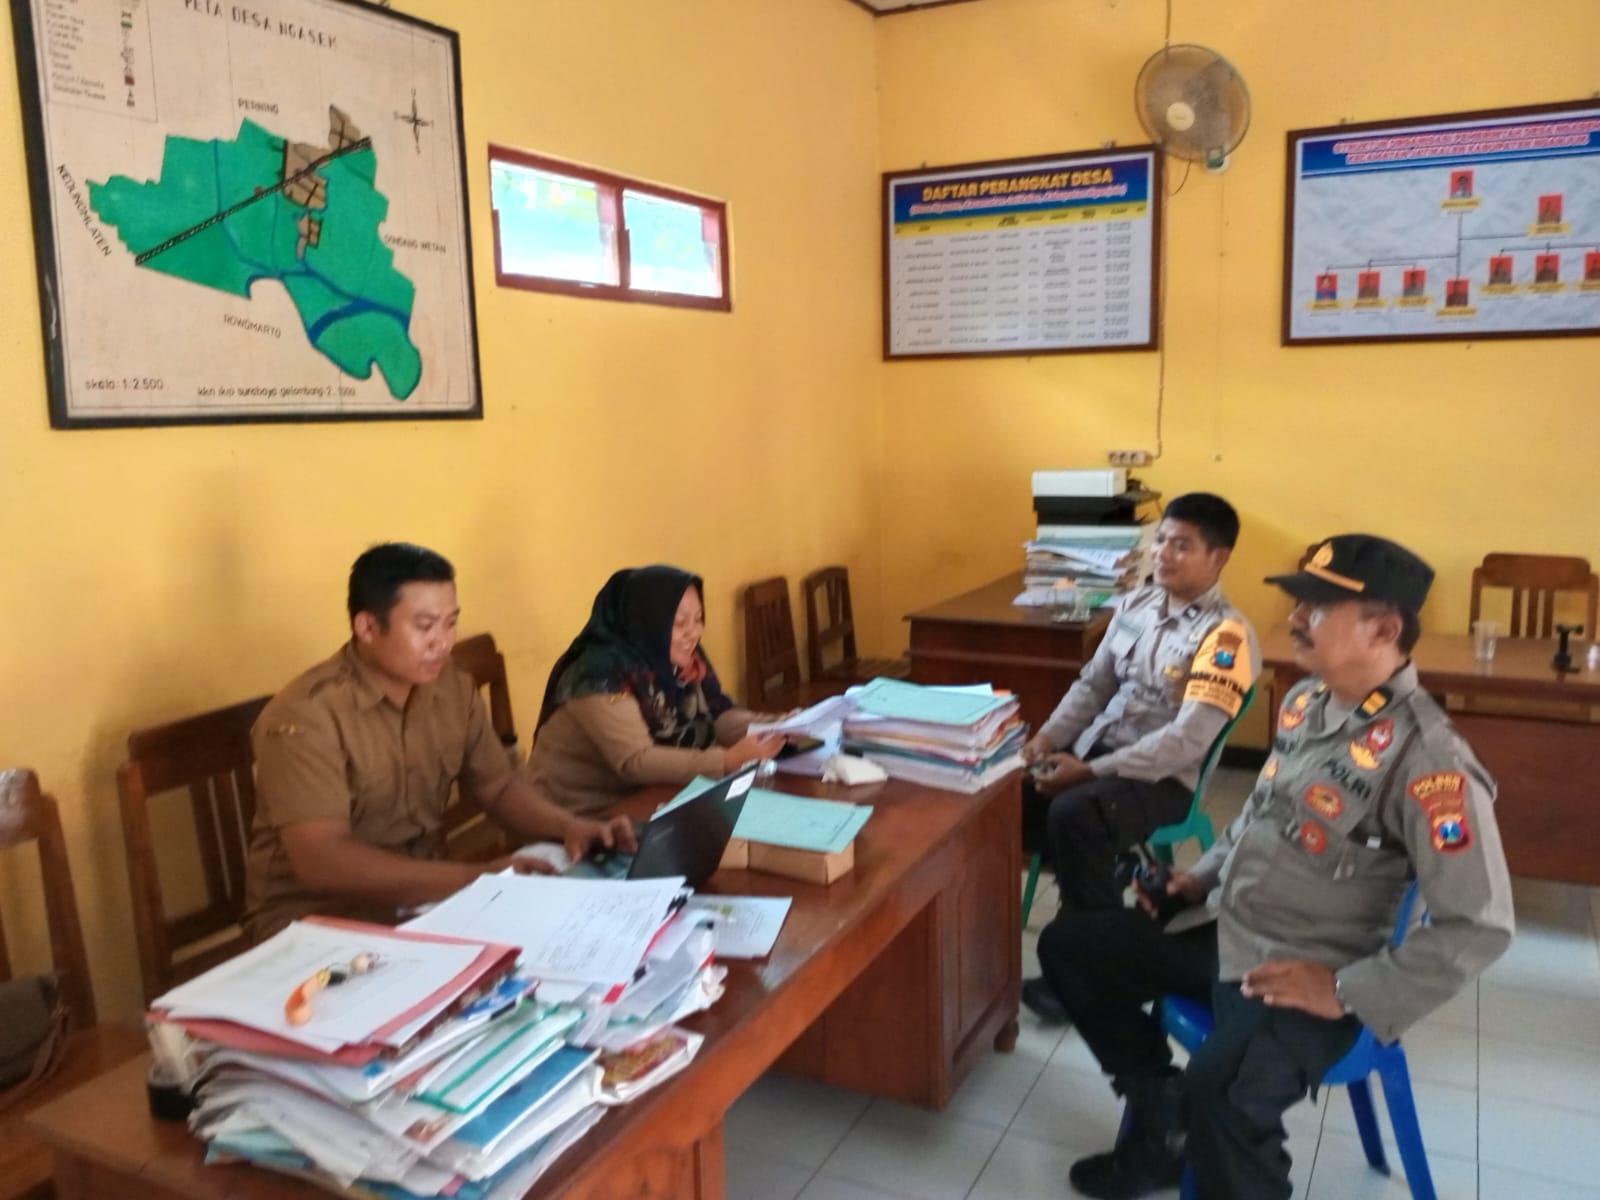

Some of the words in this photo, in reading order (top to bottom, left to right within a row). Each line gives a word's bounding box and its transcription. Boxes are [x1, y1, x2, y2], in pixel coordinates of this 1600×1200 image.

[232, 5, 271, 32] DESA
[279, 20, 338, 49] NGASEM
[922, 182, 977, 202] DAFTAR
[979, 173, 1069, 197] PERANGKAT
[1070, 167, 1113, 187] DESA
[1322, 757, 1372, 800] POLRI
